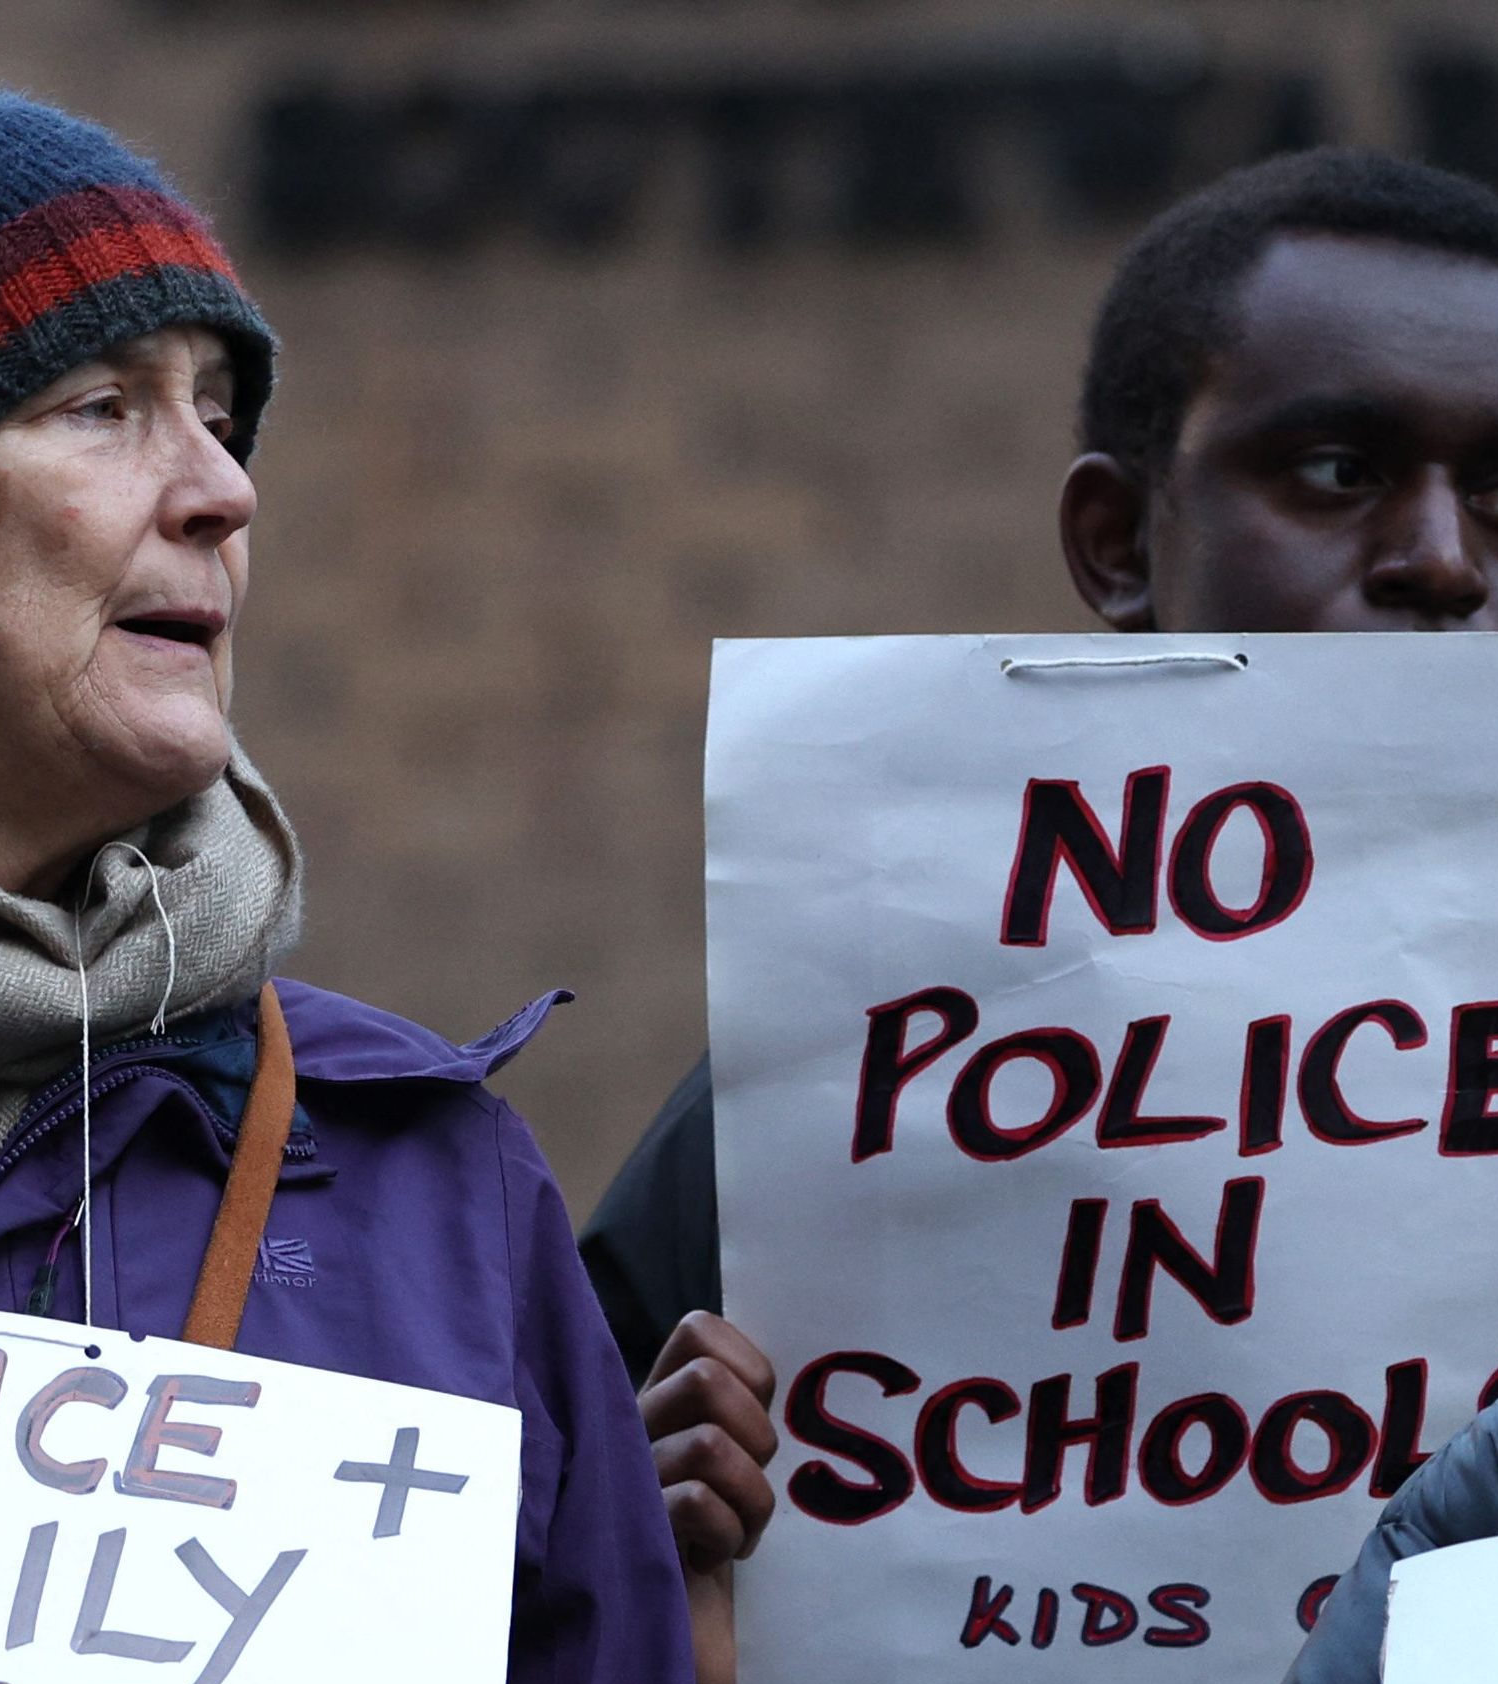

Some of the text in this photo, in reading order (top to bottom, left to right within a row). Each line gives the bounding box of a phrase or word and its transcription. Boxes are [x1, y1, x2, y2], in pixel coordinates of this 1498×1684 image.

[999, 764, 1315, 943] NO
[1049, 1175, 1266, 1344] IN
[332, 1426, 471, 1540] +
[958, 1574, 1212, 1650] KIDS
